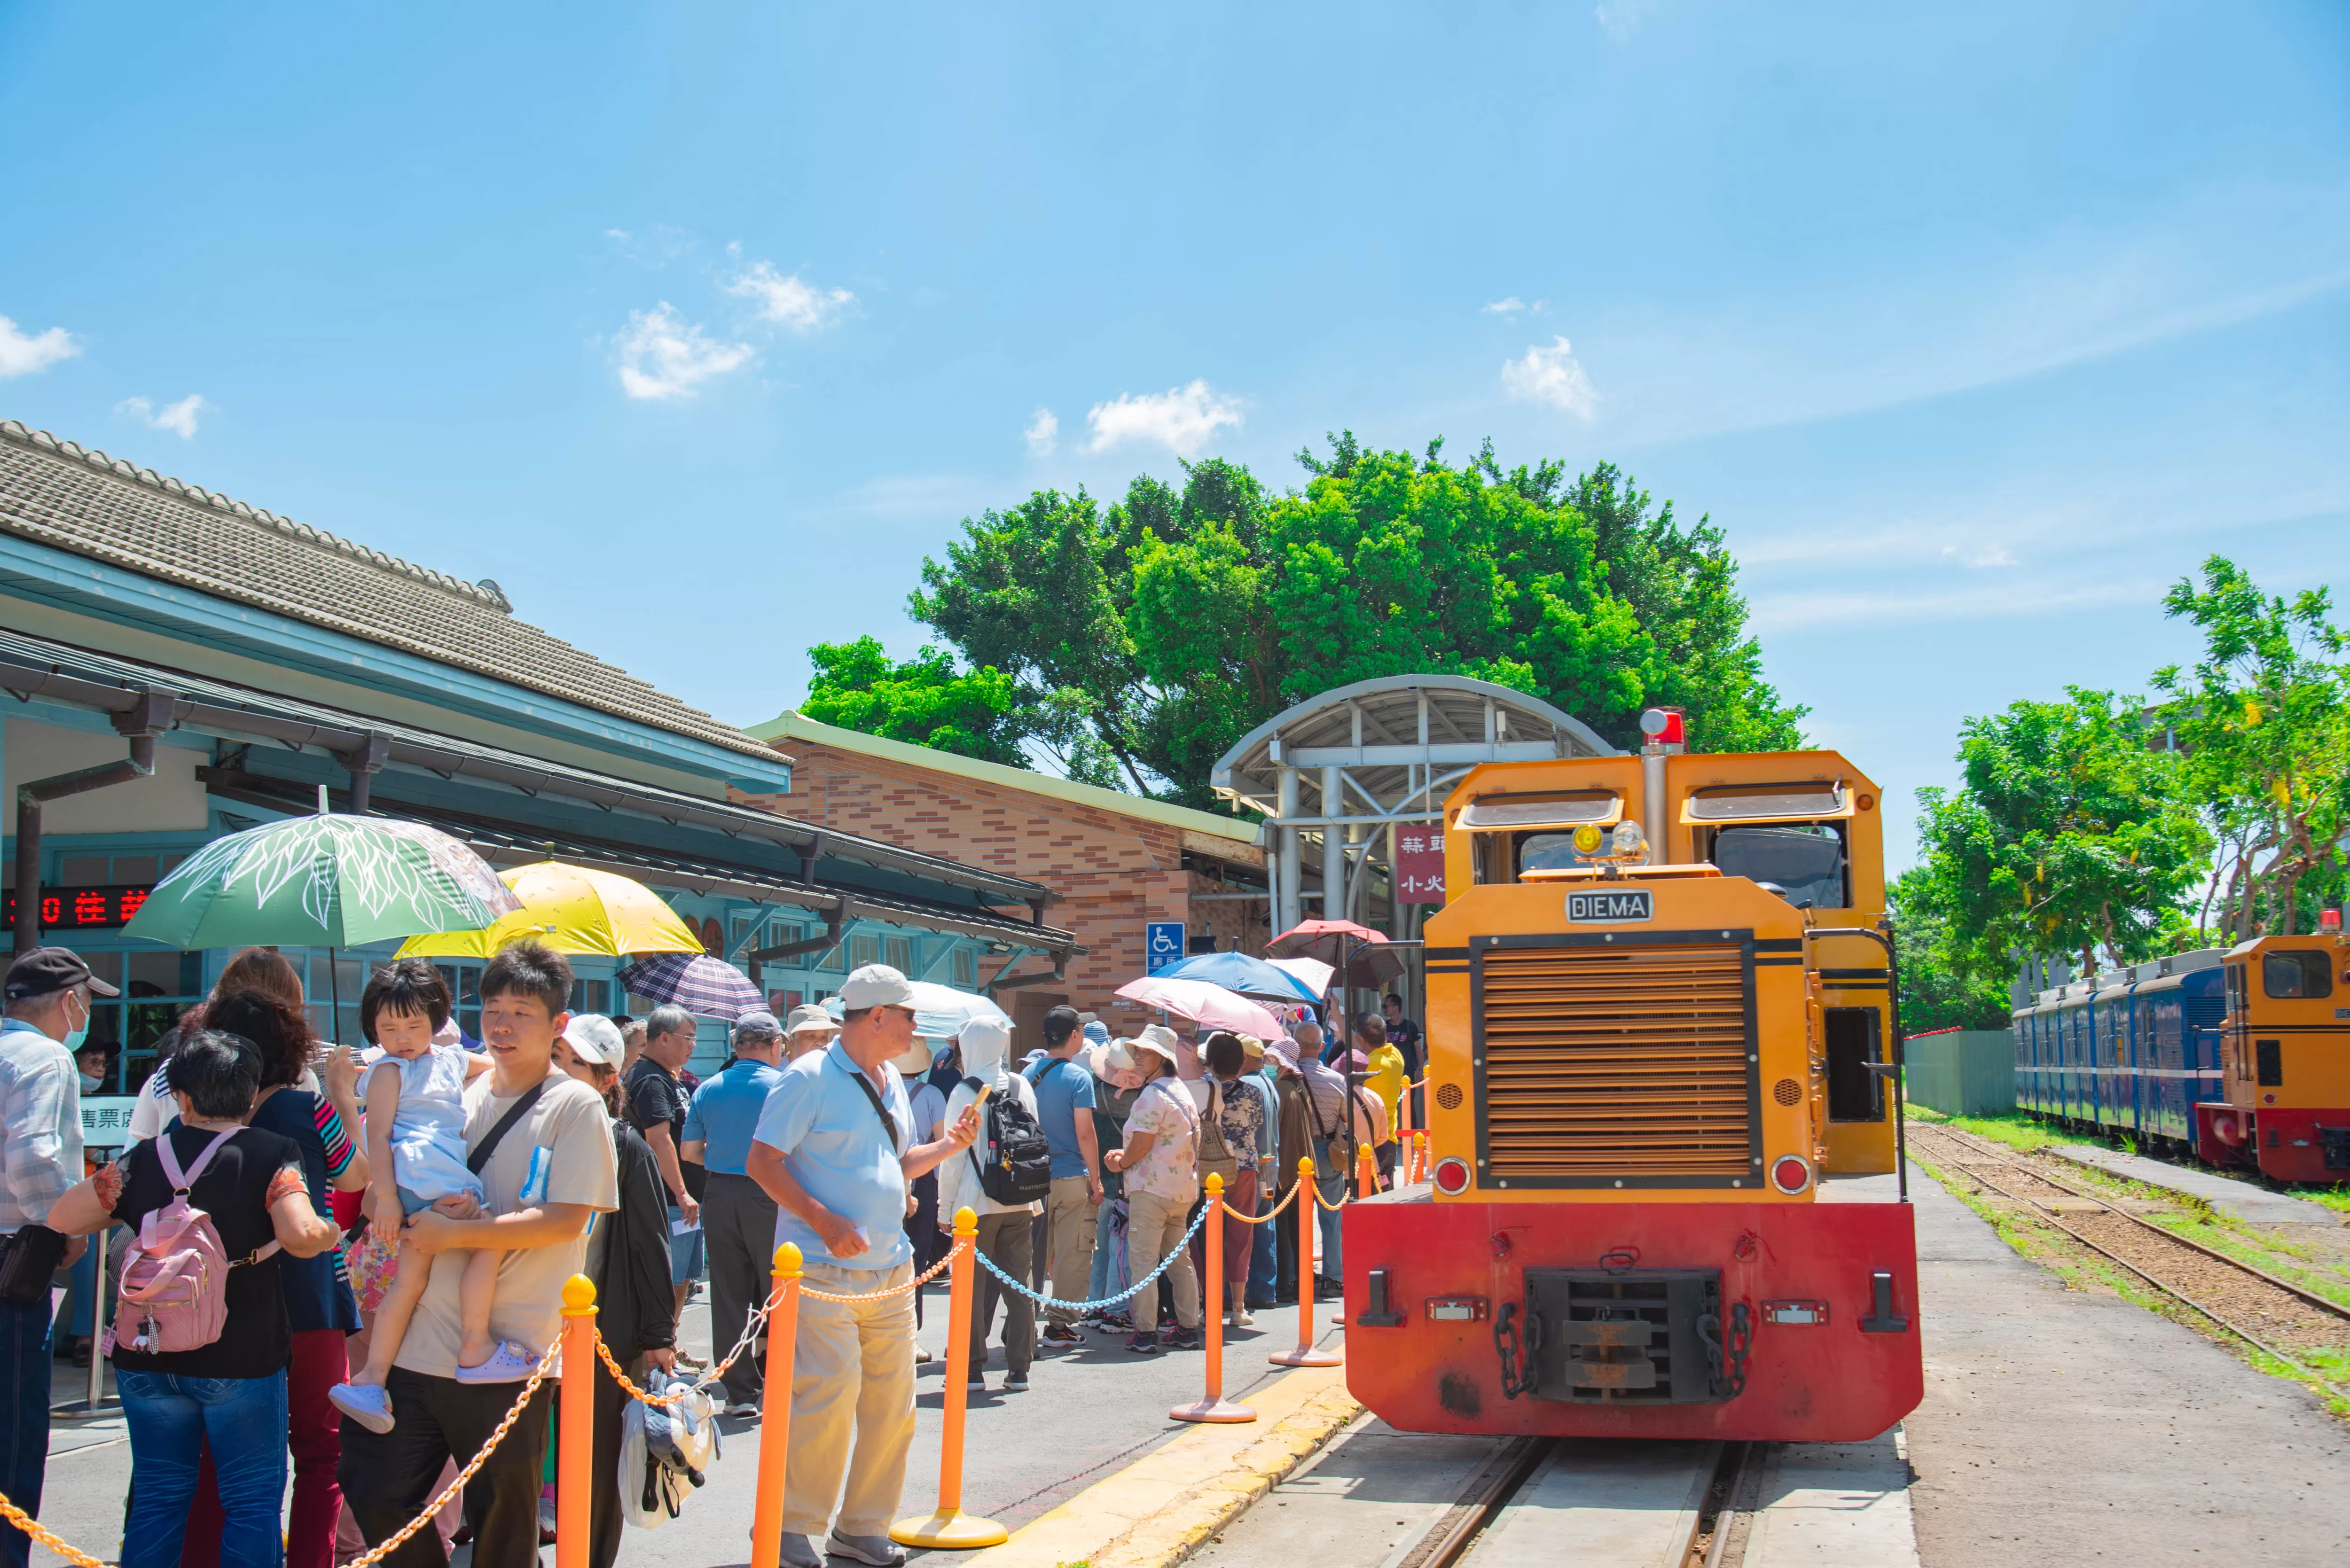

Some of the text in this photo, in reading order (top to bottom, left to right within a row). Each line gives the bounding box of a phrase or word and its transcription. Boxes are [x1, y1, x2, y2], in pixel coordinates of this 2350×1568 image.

[1401, 835, 1445, 853] 蒜頭
[1401, 875, 1446, 893] 小火
[1572, 896, 1646, 917] DIEMA
